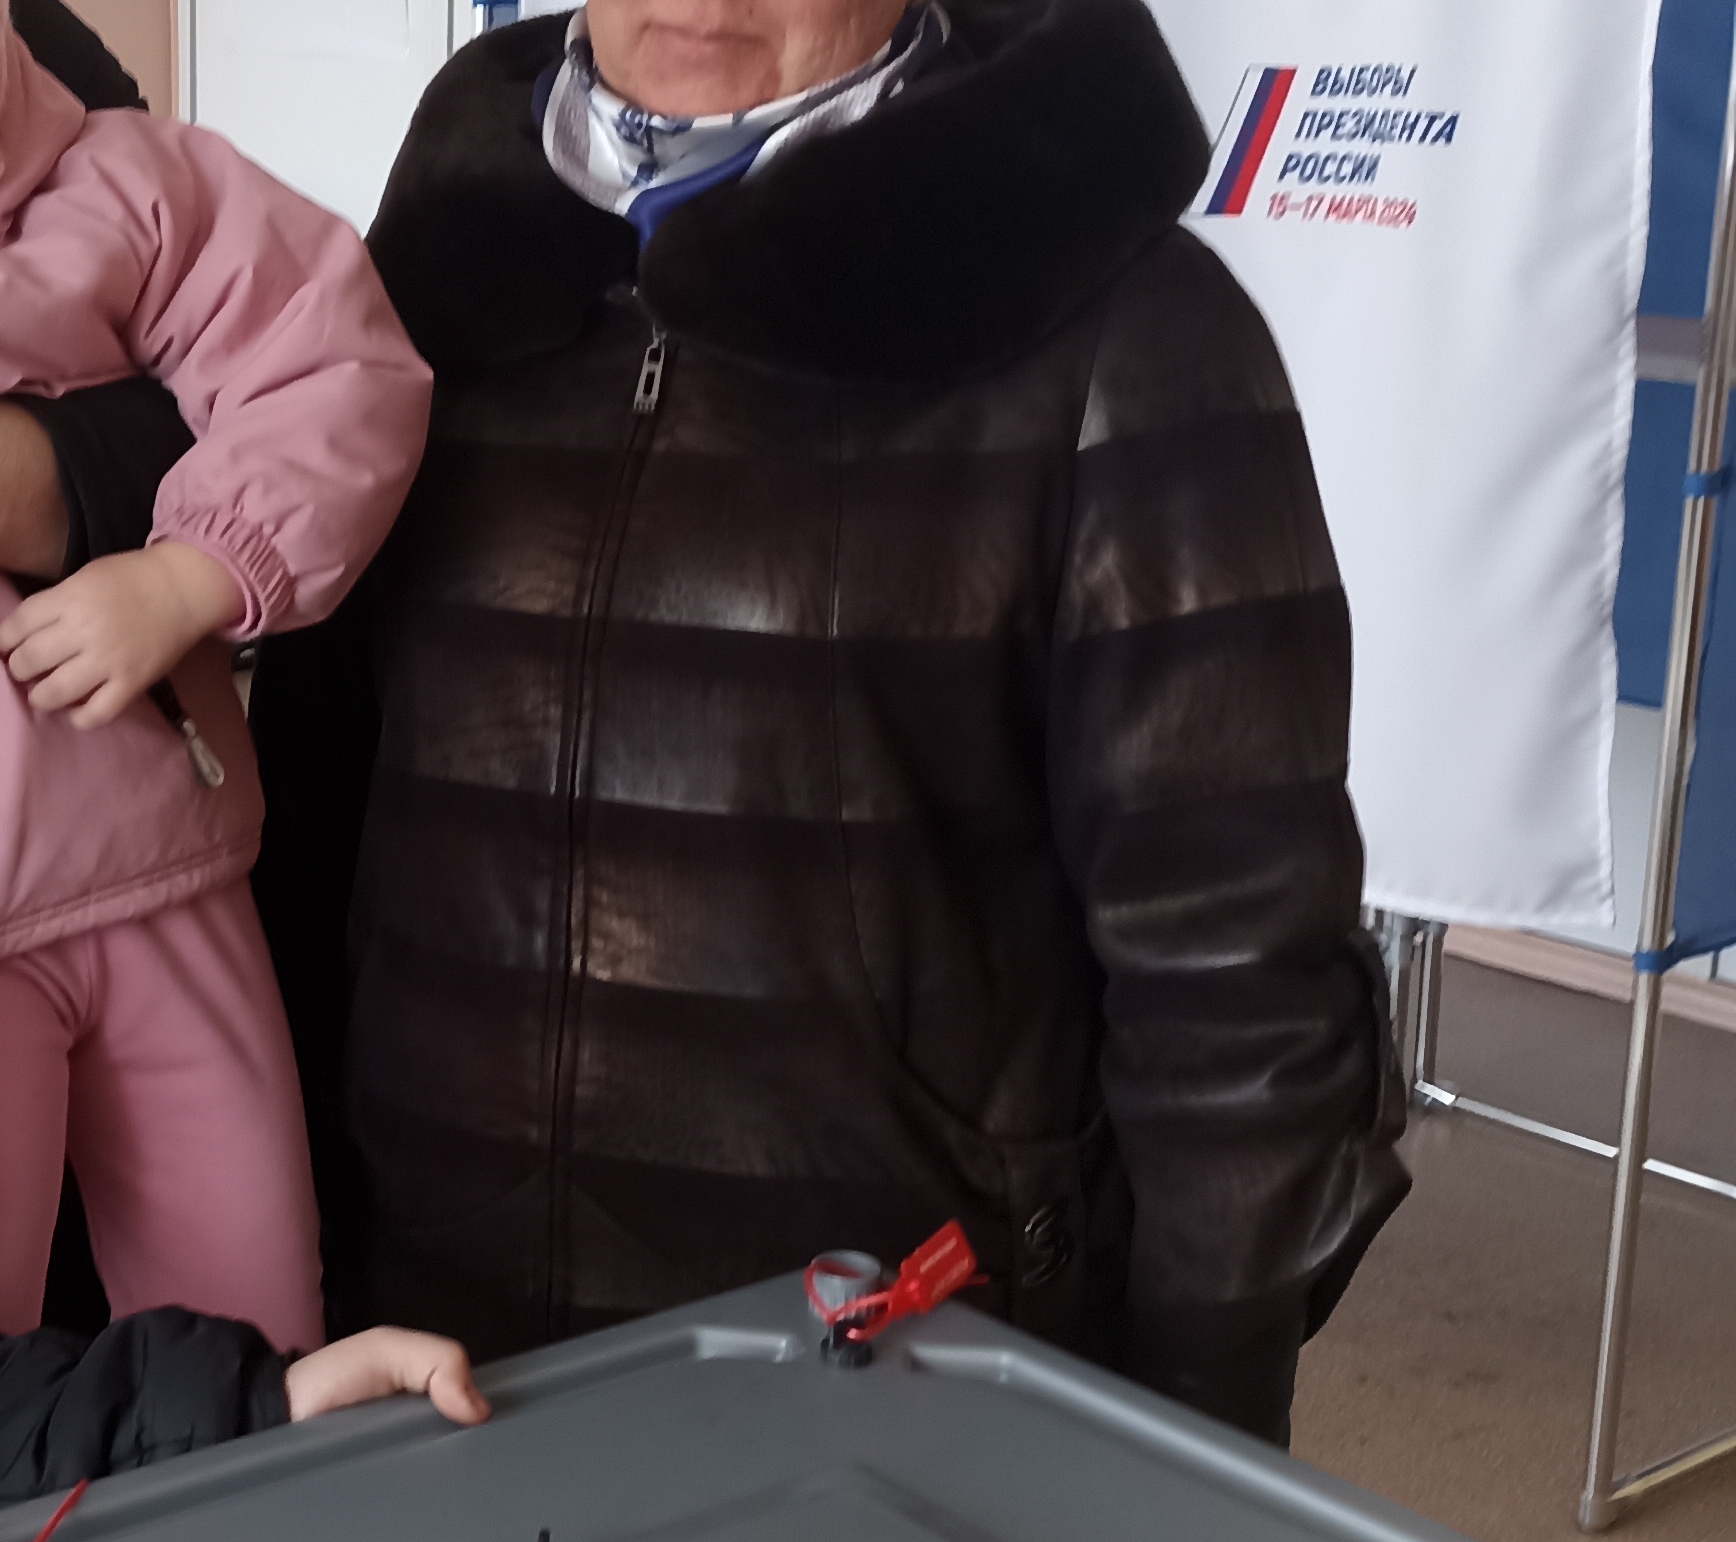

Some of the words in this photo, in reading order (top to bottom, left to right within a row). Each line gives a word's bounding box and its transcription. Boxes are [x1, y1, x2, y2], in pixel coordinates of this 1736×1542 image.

[1310, 62, 1418, 98] ВЫБОРЫ
[1294, 108, 1461, 146] ПРЕЗИДЕНТА
[1277, 152, 1382, 185] РОССИИ
